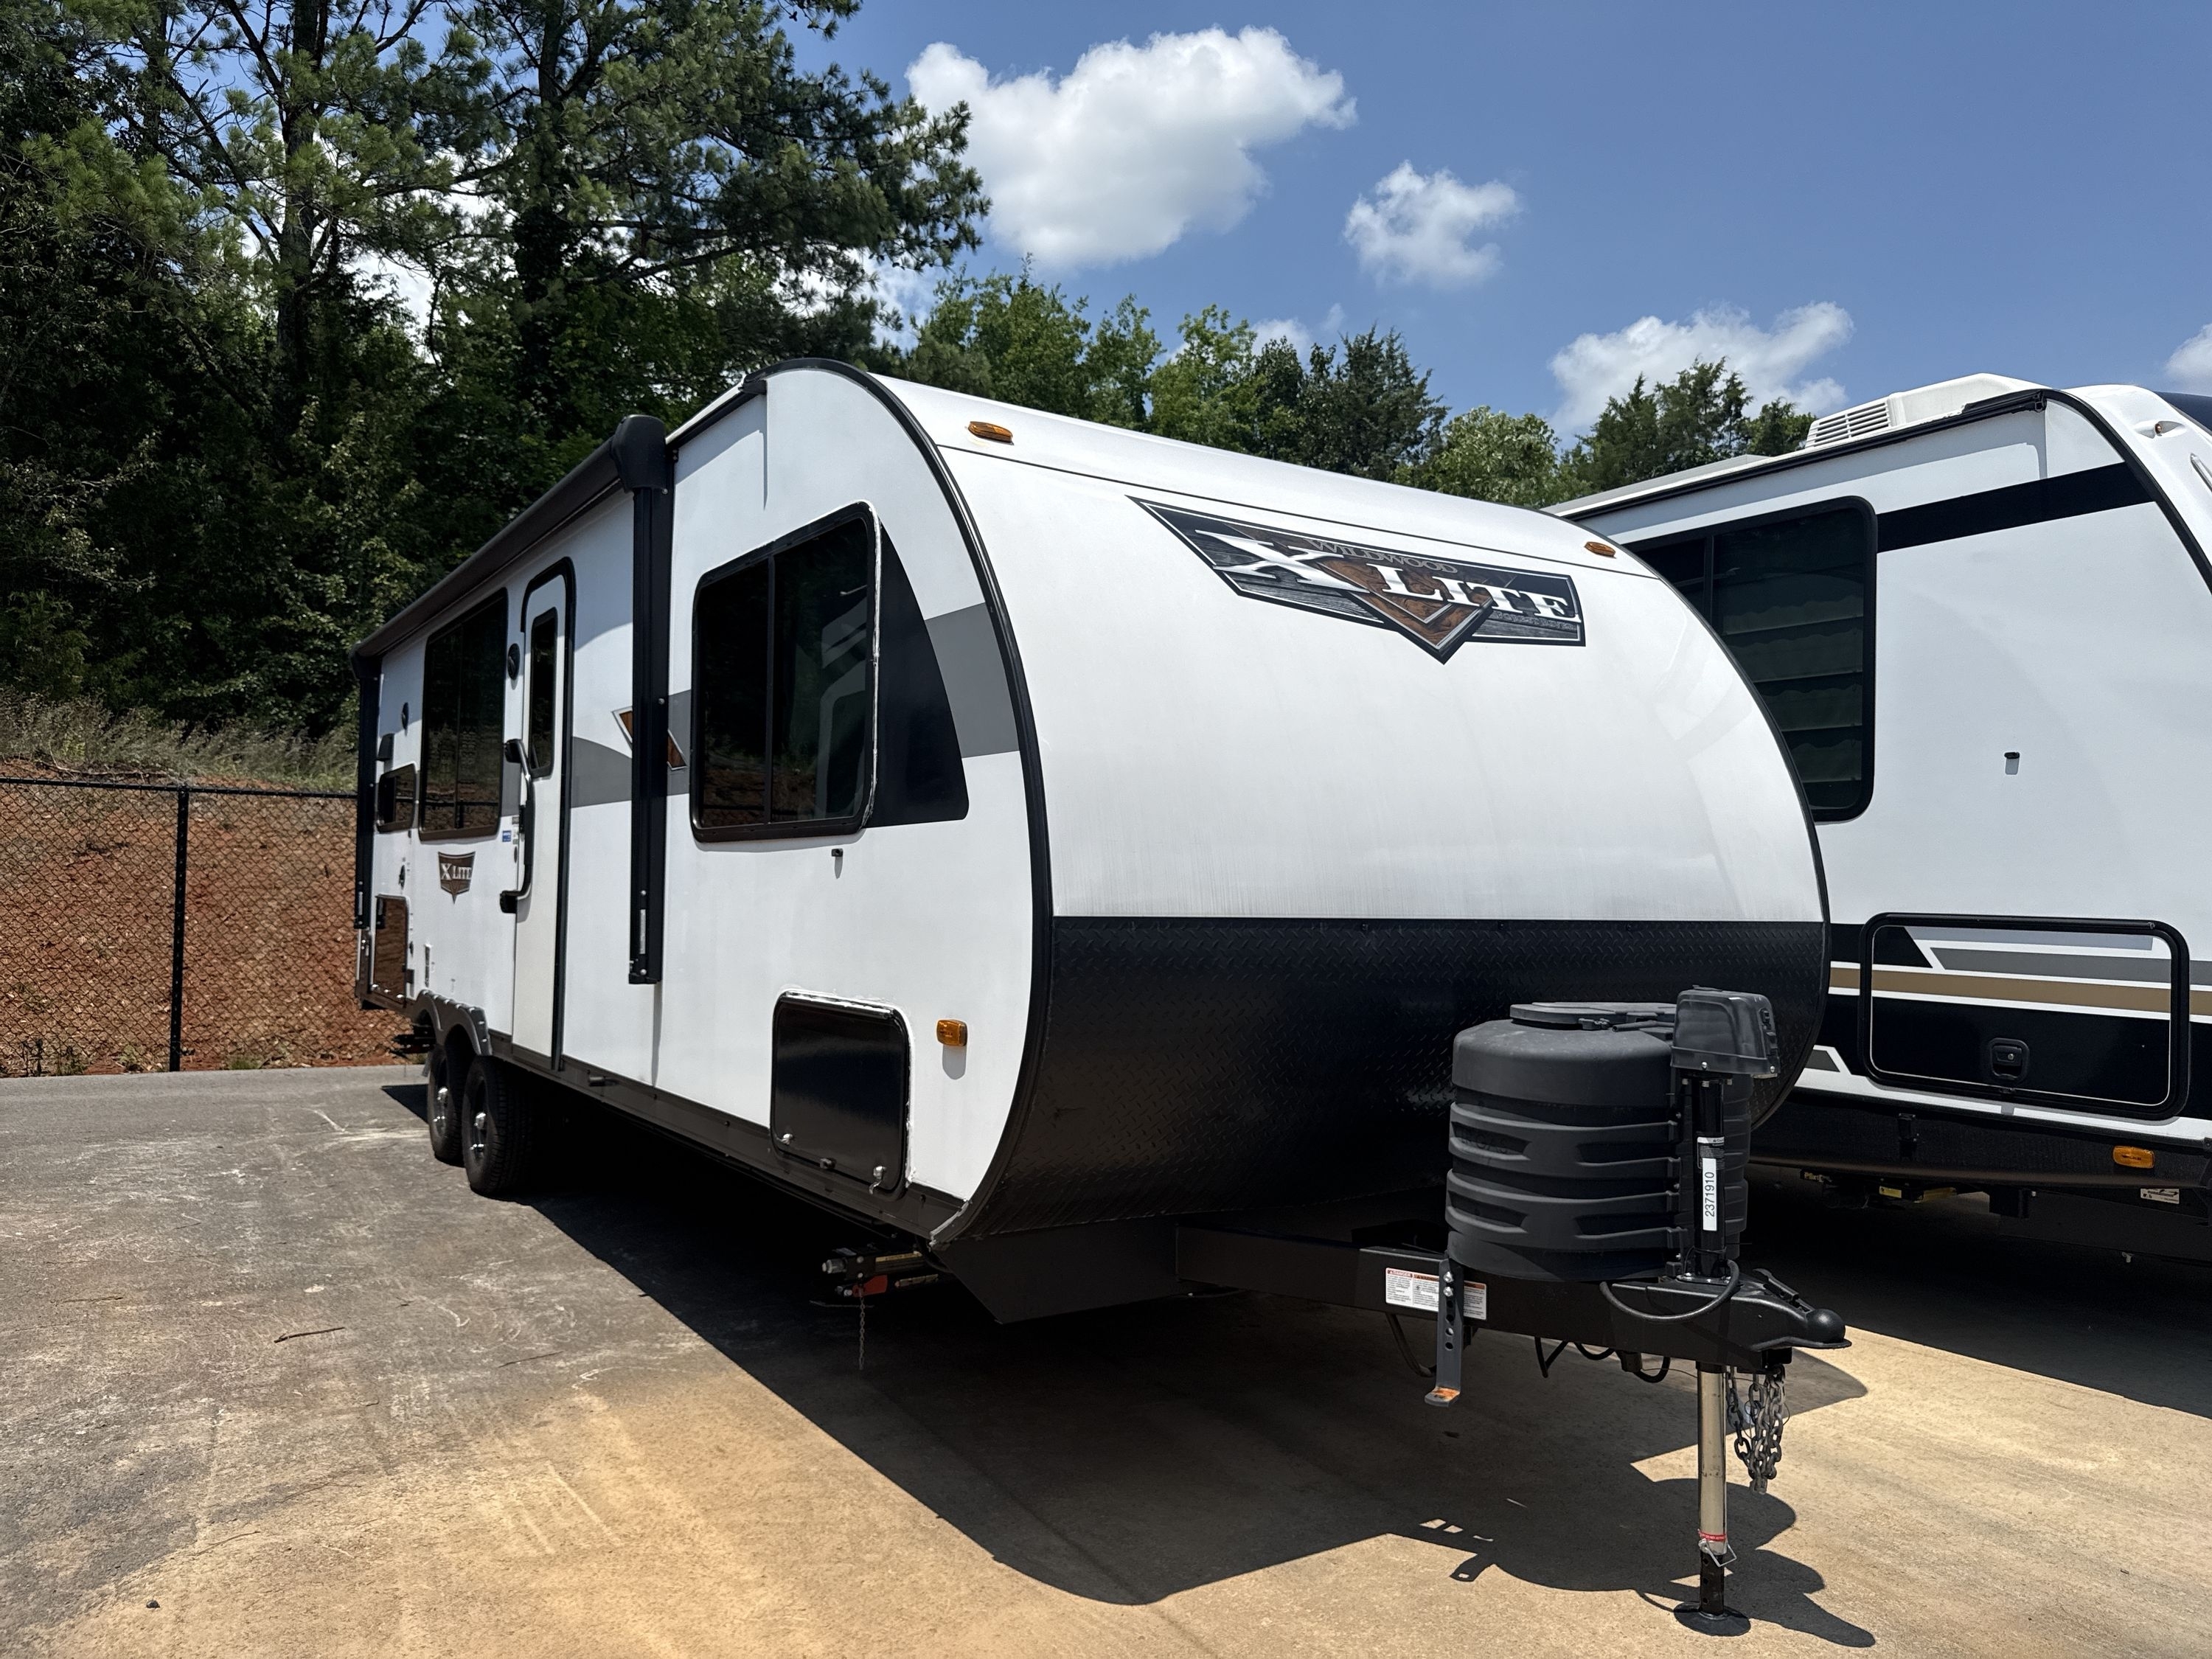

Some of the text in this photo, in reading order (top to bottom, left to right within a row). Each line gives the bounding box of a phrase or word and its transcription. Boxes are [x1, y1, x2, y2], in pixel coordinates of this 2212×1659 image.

[1303, 538, 1458, 574] WILDWOOD
[1365, 563, 1582, 624] LITE
[1704, 1172, 1715, 1217] 2371910
